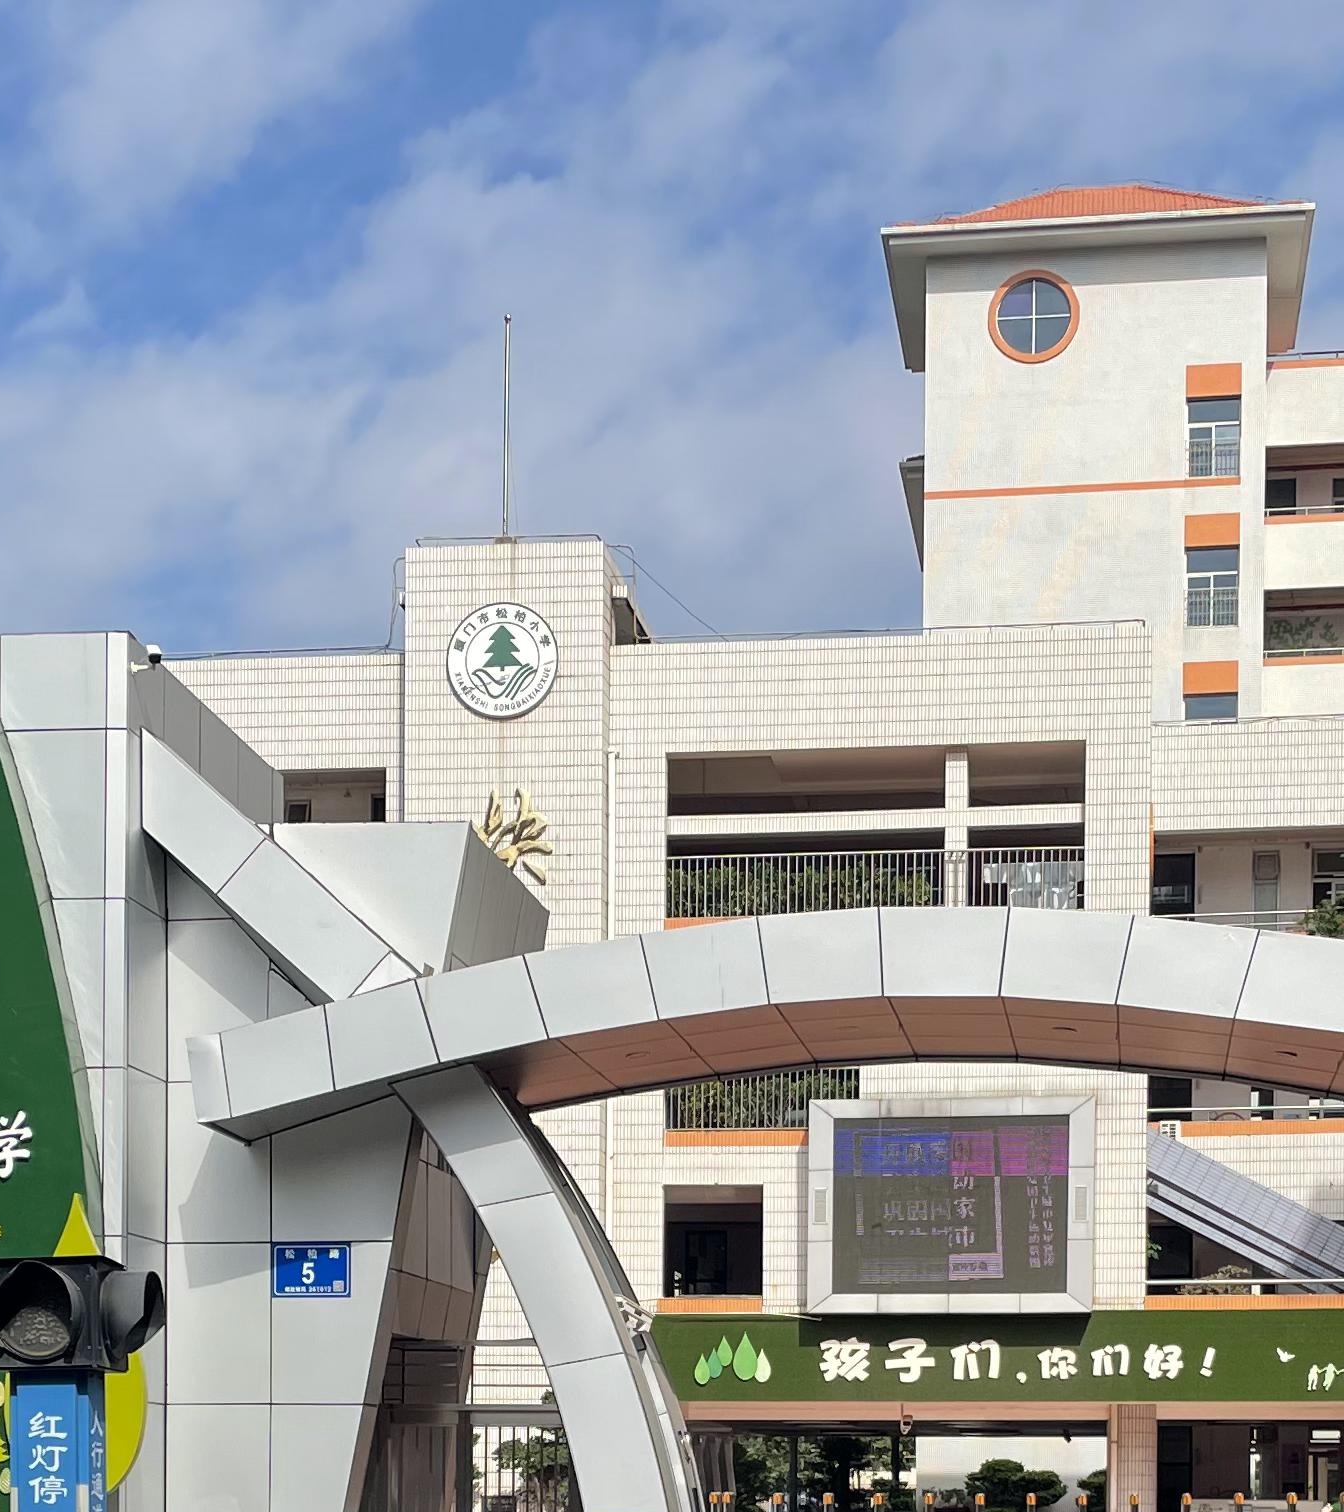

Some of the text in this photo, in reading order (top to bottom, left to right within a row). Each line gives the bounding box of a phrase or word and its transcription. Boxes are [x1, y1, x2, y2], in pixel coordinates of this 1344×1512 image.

[454, 607, 551, 652] 厦门市松柏小学
[284, 1248, 340, 1260] 松柏路
[301, 1262, 315, 1285] 5
[27, 1411, 69, 1505] 红灯停
